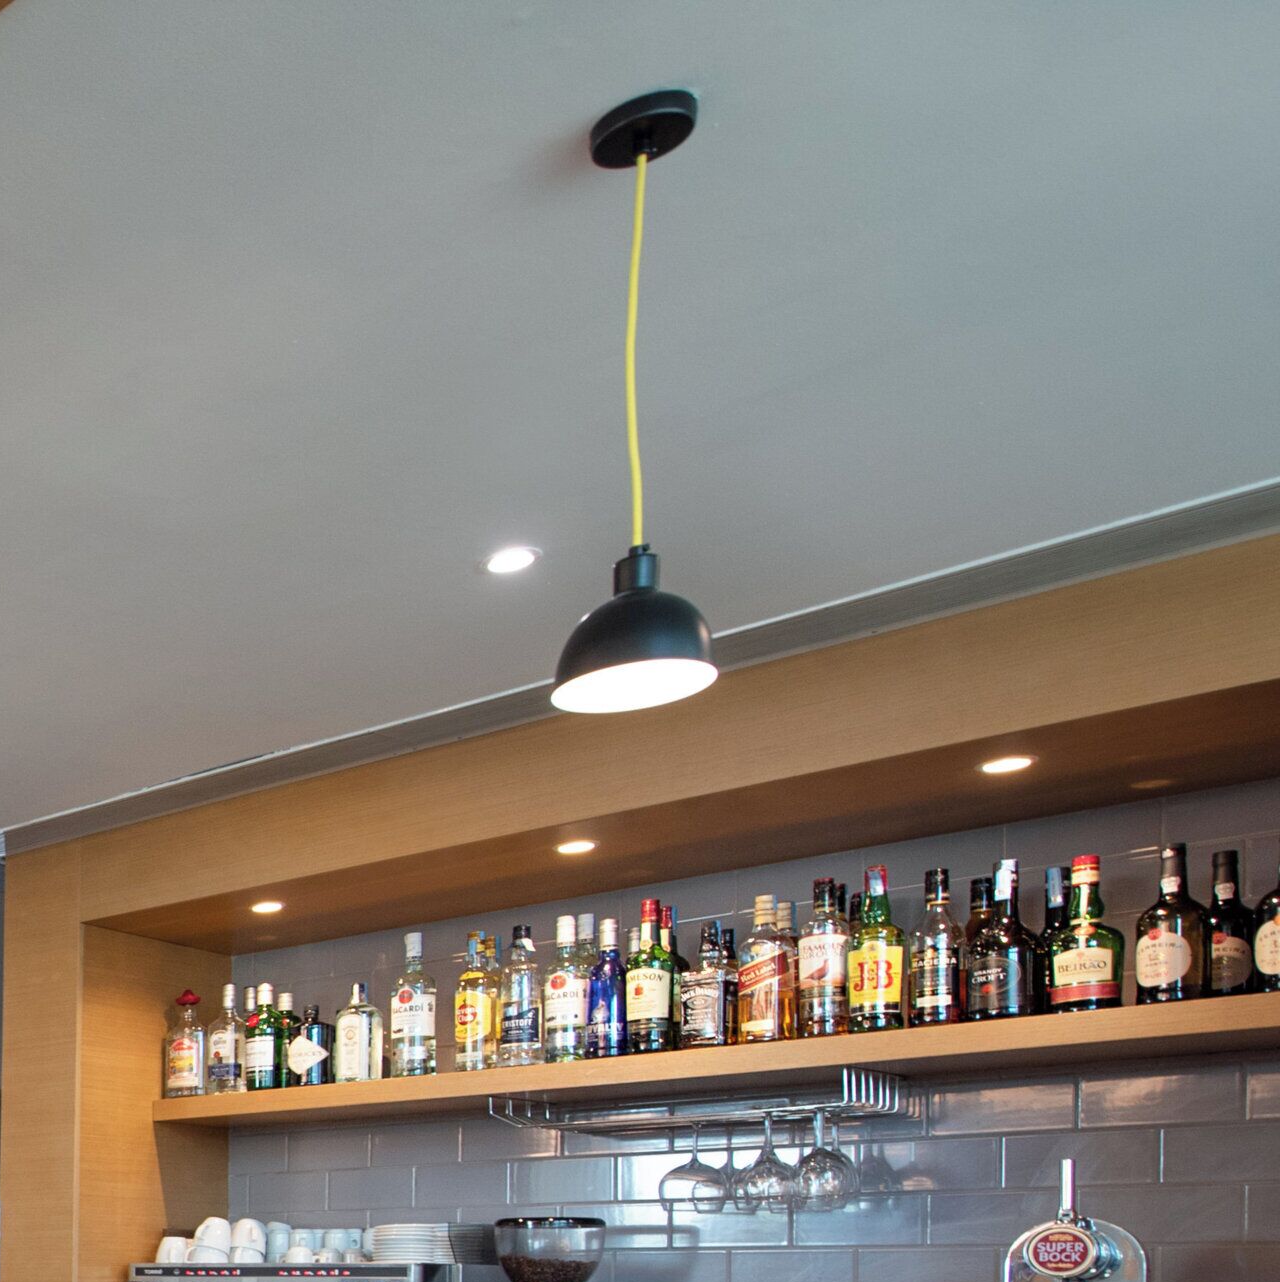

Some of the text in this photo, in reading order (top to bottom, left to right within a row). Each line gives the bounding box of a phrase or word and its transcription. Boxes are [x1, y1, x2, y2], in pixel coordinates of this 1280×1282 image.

[1213, 946, 1246, 954] REIRA
[912, 957, 957, 969] MACIERA
[1057, 959, 1107, 974] BEIRÃO
[627, 972, 664, 983] AMESON
[740, 971, 756, 983] Red
[853, 960, 894, 992] J&B
[971, 973, 1007, 984] CROFT
[546, 990, 579, 1001] ACARDÍ
[1036, 1242, 1085, 1252] SUPER
[1038, 1252, 1082, 1262] BOCK
